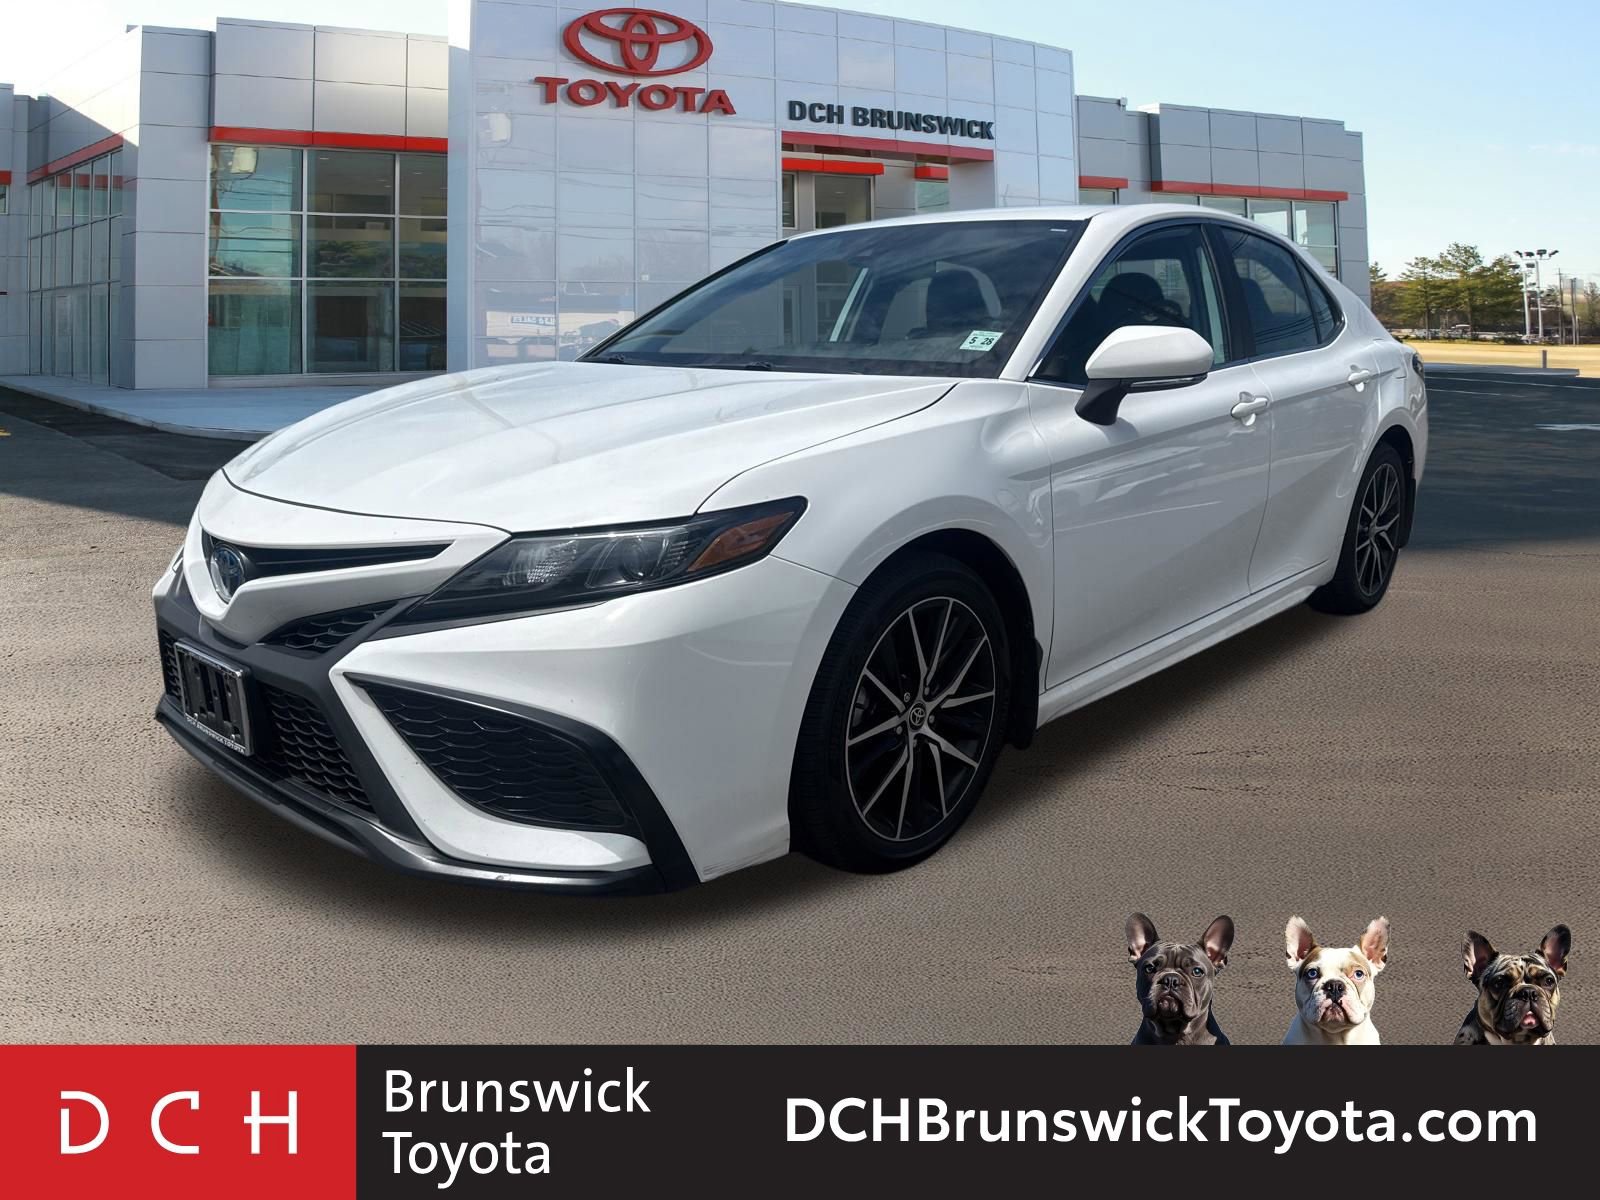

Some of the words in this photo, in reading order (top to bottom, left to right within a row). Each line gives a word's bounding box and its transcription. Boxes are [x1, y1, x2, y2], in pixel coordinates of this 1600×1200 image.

[534, 76, 737, 115] TOYOTA
[788, 100, 845, 125] DCH
[852, 106, 995, 141] BRUNSWICK
[969, 336, 978, 345] 5
